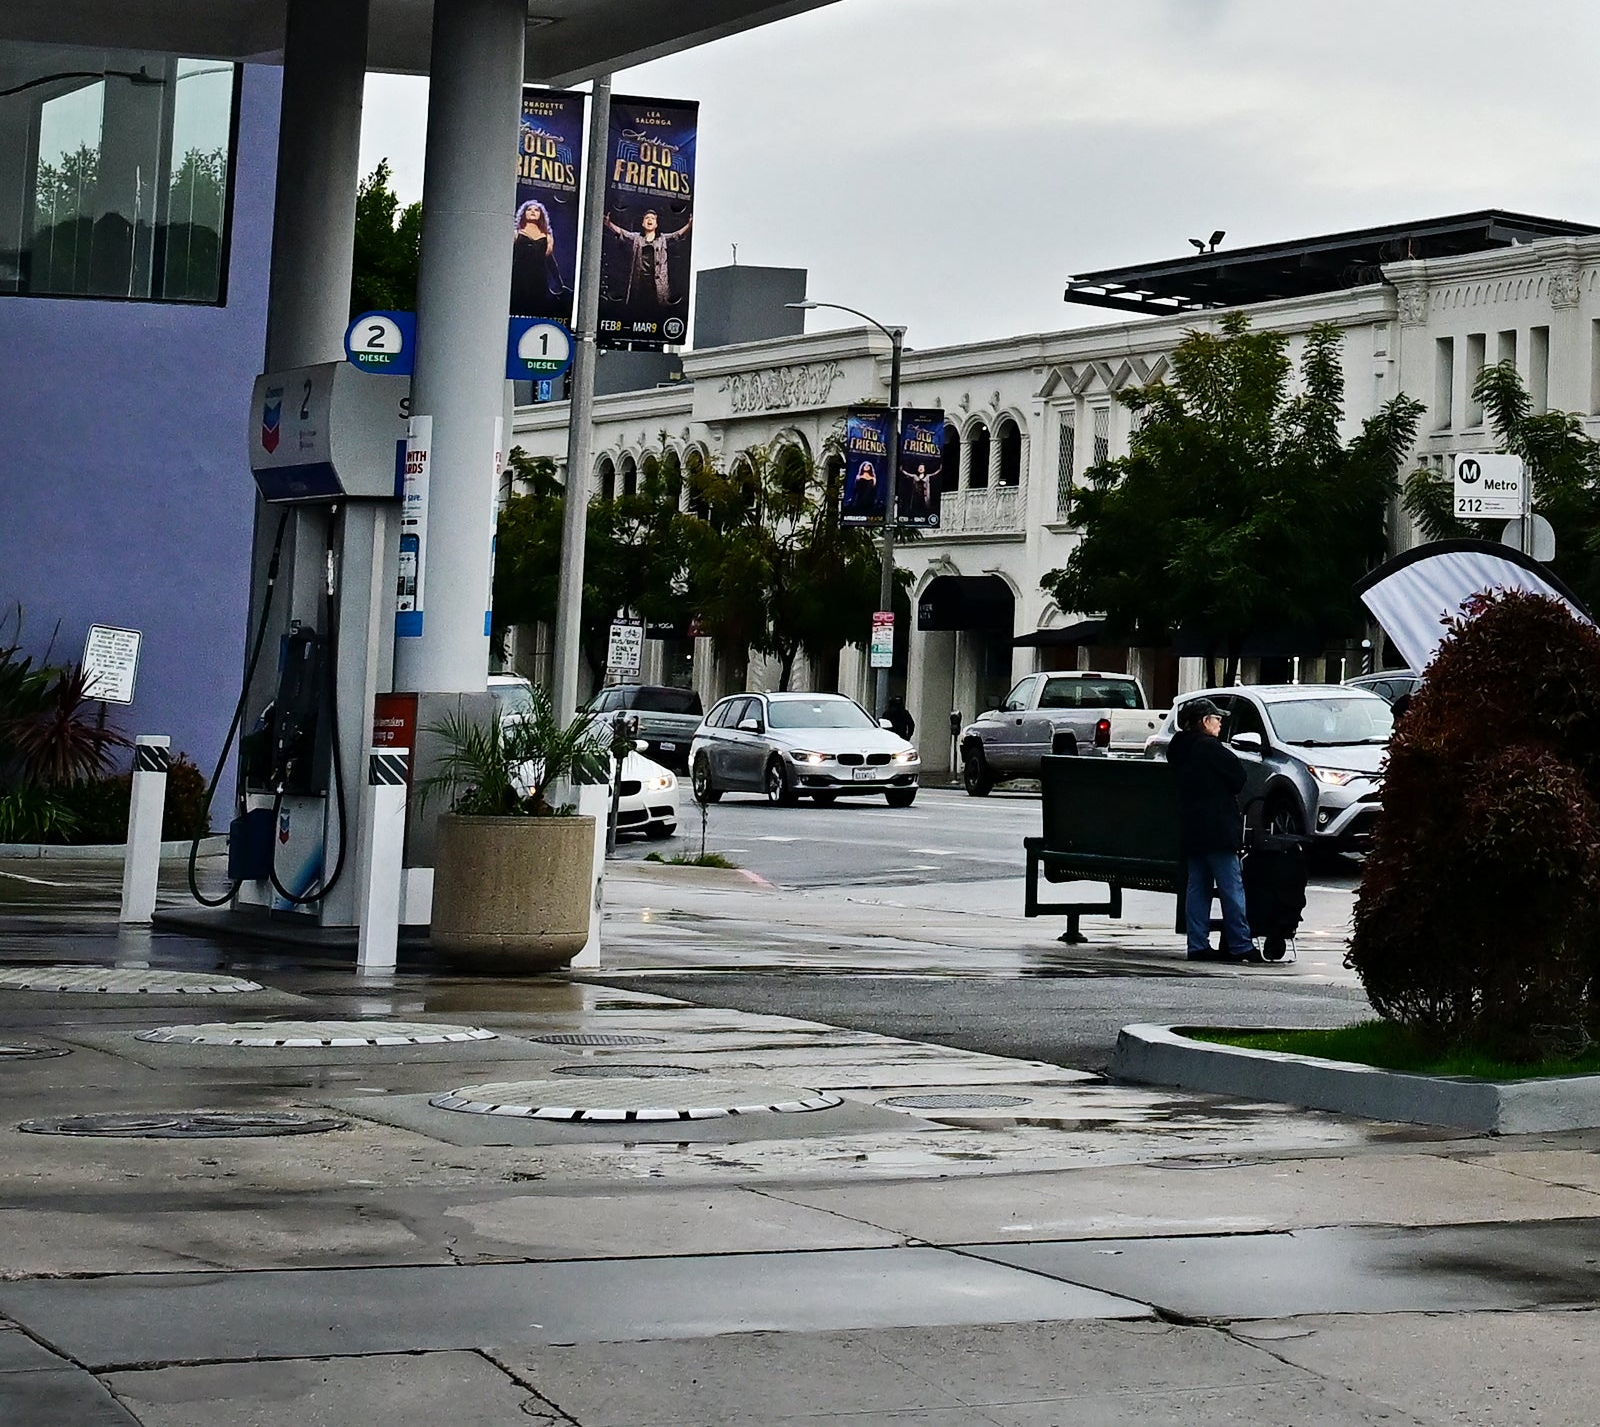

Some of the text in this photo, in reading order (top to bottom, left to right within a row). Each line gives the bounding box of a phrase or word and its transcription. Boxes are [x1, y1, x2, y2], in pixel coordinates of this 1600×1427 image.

[635, 117, 672, 126] SALONGA
[524, 133, 557, 158] OLD
[640, 143, 672, 168] OLD
[613, 158, 690, 195] FRIENDS
[600, 320, 622, 331] FEB8
[632, 322, 658, 334] MAR9
[367, 325, 385, 348] 2
[539, 333, 549, 356] 1
[358, 354, 391, 363] DIESEL
[527, 361, 558, 370] DIESEL
[301, 378, 313, 420] 2
[862, 428, 878, 441] OLD
[916, 431, 932, 442] OLD
[850, 437, 887, 453] FRIENDS
[1484, 479, 1518, 491] Metro
[1458, 498, 1482, 512] 212
